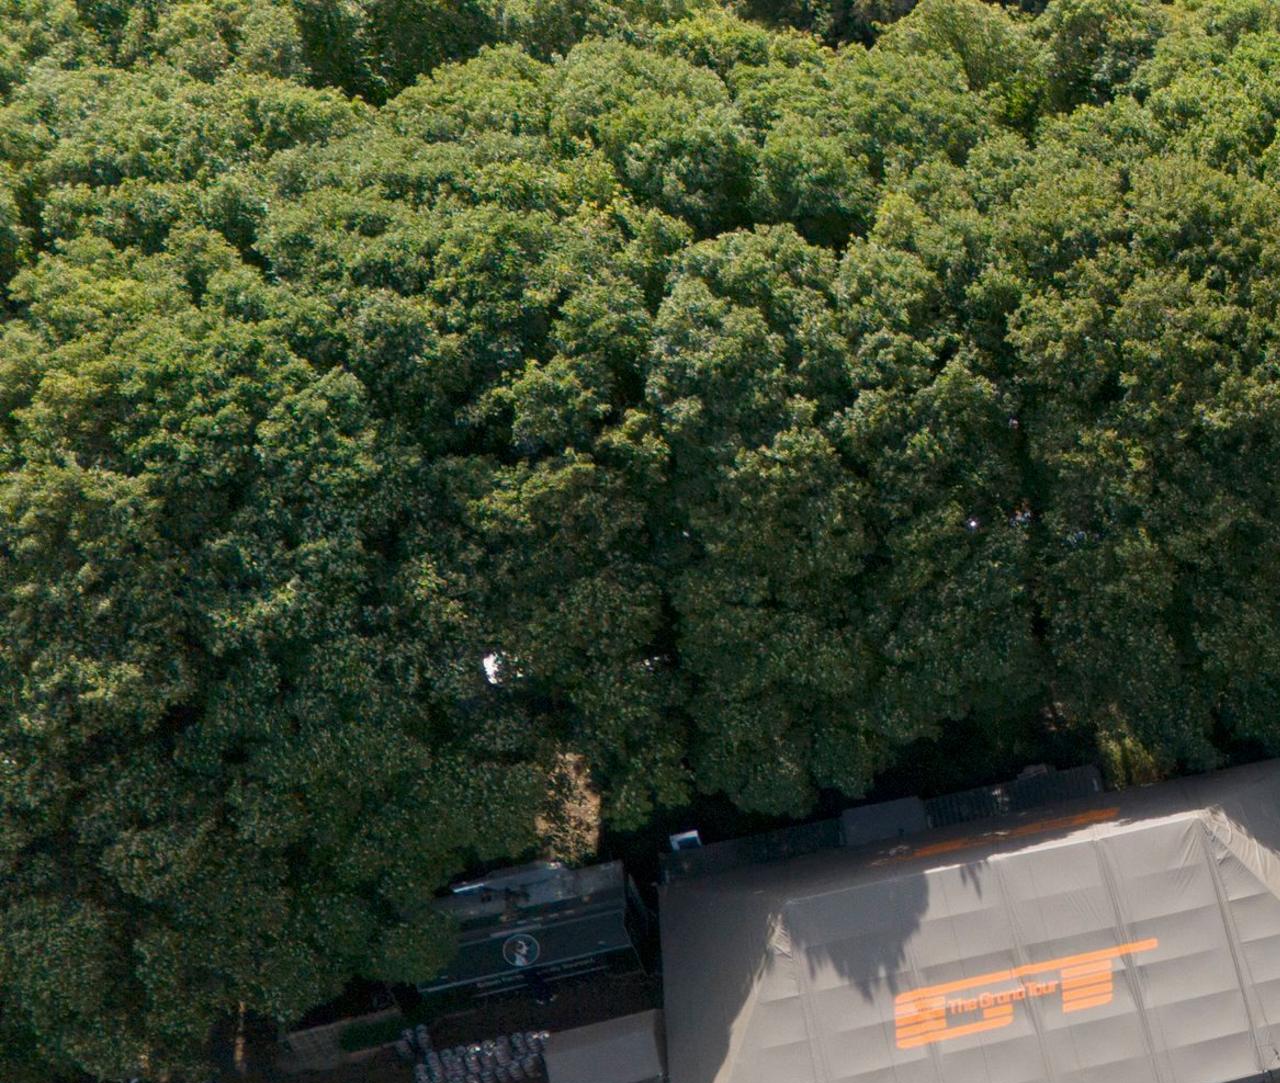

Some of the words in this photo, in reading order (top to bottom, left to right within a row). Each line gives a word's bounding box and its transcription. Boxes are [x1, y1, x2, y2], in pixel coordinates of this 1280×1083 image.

[947, 999, 977, 1014] The
[979, 986, 1025, 1007] Grand
[1026, 980, 1059, 997] Tour
